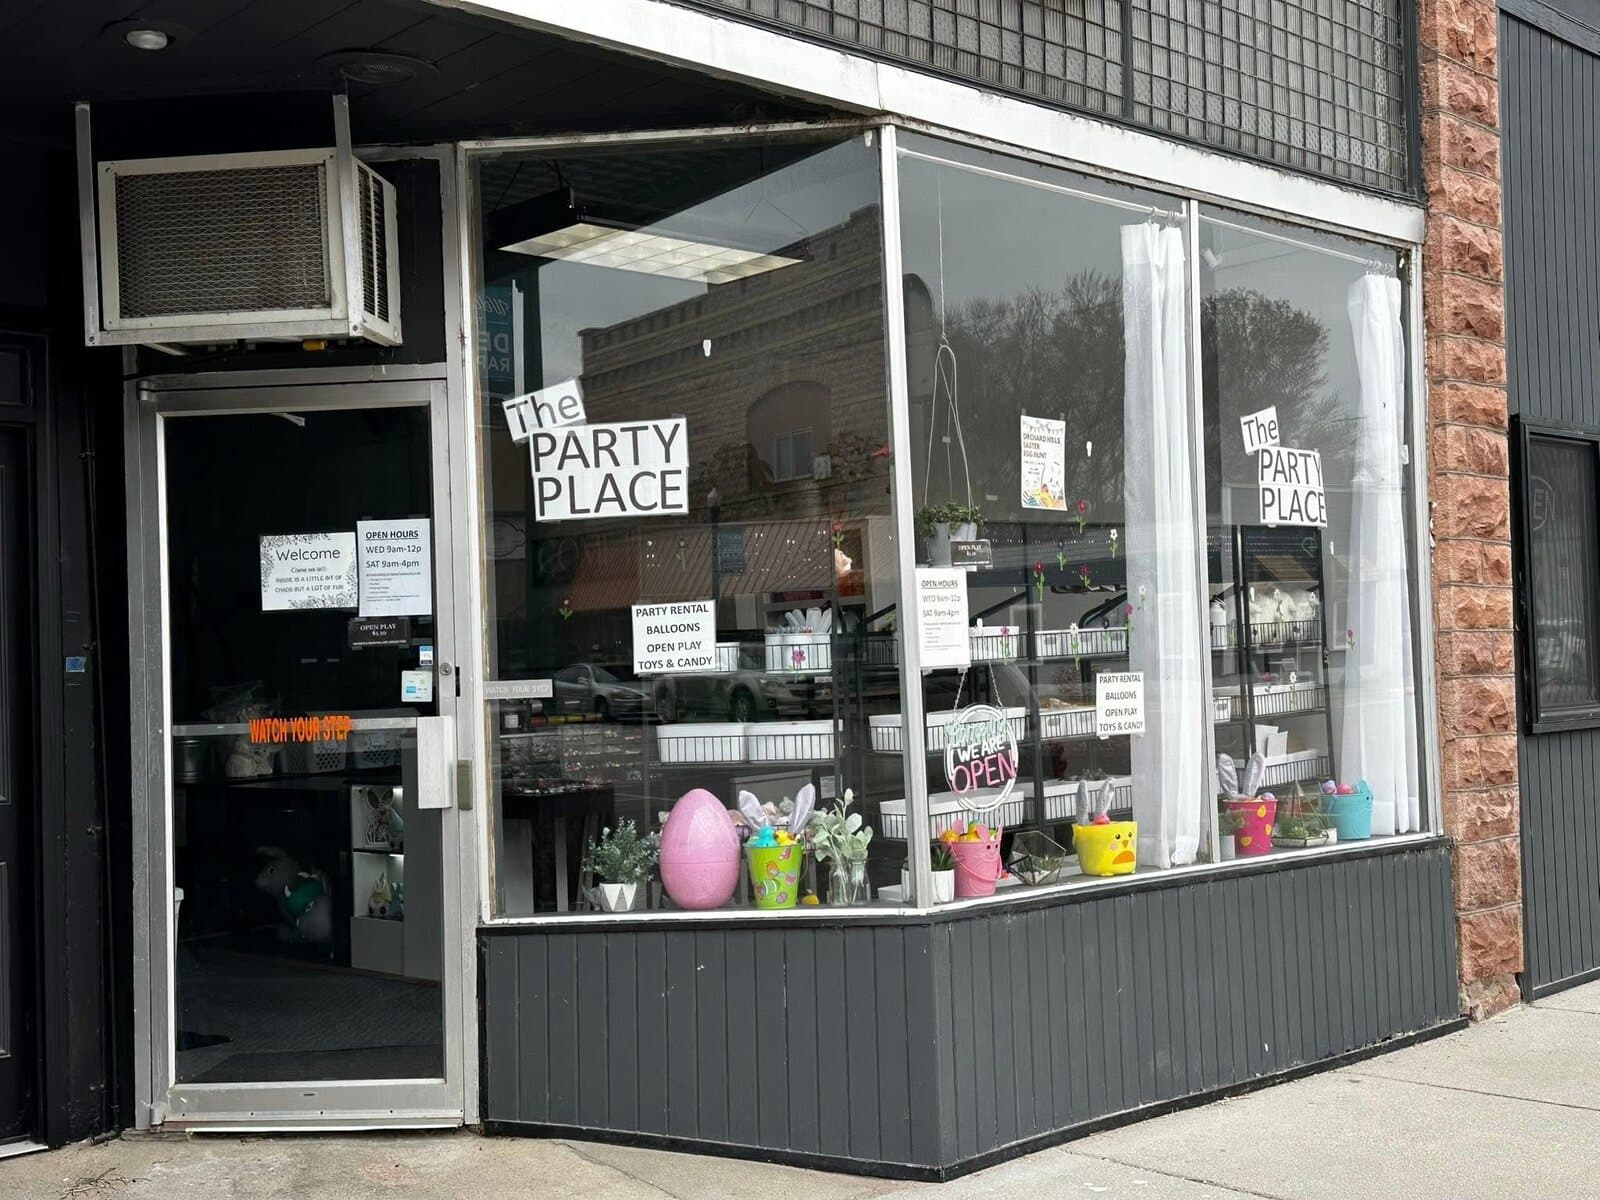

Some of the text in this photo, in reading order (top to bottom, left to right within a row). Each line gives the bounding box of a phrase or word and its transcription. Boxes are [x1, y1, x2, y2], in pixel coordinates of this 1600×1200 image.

[505, 394, 581, 434] The
[1243, 416, 1278, 447] The
[532, 423, 681, 473] PARTY
[1260, 448, 1321, 487] PARTY
[537, 469, 683, 517] PLACE
[1261, 487, 1327, 524] PLACE
[365, 530, 419, 540] OPEN HOURS
[275, 548, 341, 562] Welcome
[365, 545, 422, 554] WED 9am-12p
[366, 559, 420, 569] SAT 9am-4pm
[311, 584, 322, 592] LOT
[921, 580, 937, 588] OPEN
[636, 603, 709, 618] PARTY RENTAL
[646, 622, 701, 635] BALLOONS
[647, 641, 702, 653] OPEN PLAY
[638, 656, 713, 670] TOYS & CANDY
[1099, 674, 1141, 684] PARTY RENTAL
[1105, 691, 1137, 700] BALLOONS
[1105, 708, 1137, 717] OPEN PLAY
[249, 715, 352, 743] WATCH YOUR STEP
[1099, 722, 1116, 732] TOYS
[1117, 722, 1123, 731] &
[957, 735, 1005, 763] WE ARE
[951, 750, 1017, 795] OPEN
